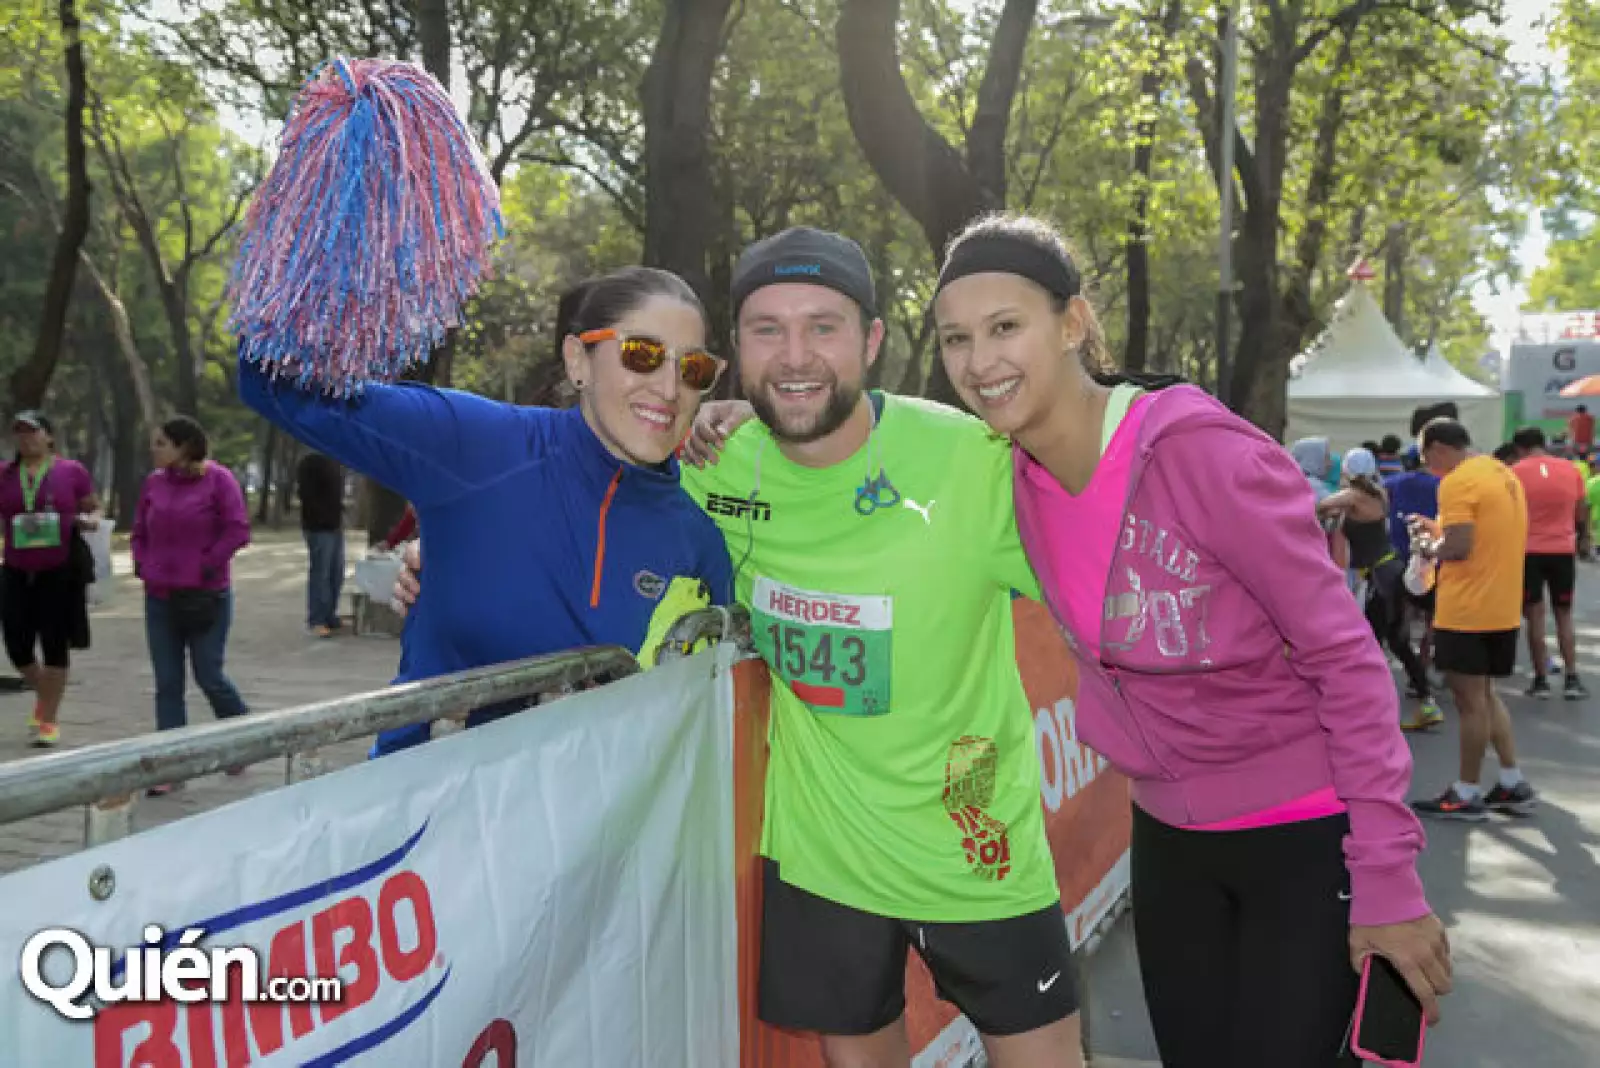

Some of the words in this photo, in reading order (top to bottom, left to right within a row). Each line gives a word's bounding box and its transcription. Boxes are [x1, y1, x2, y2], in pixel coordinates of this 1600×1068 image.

[706, 493, 770, 521] ESPN
[769, 589, 861, 626] HERDEZ
[767, 622, 867, 687] 1543
